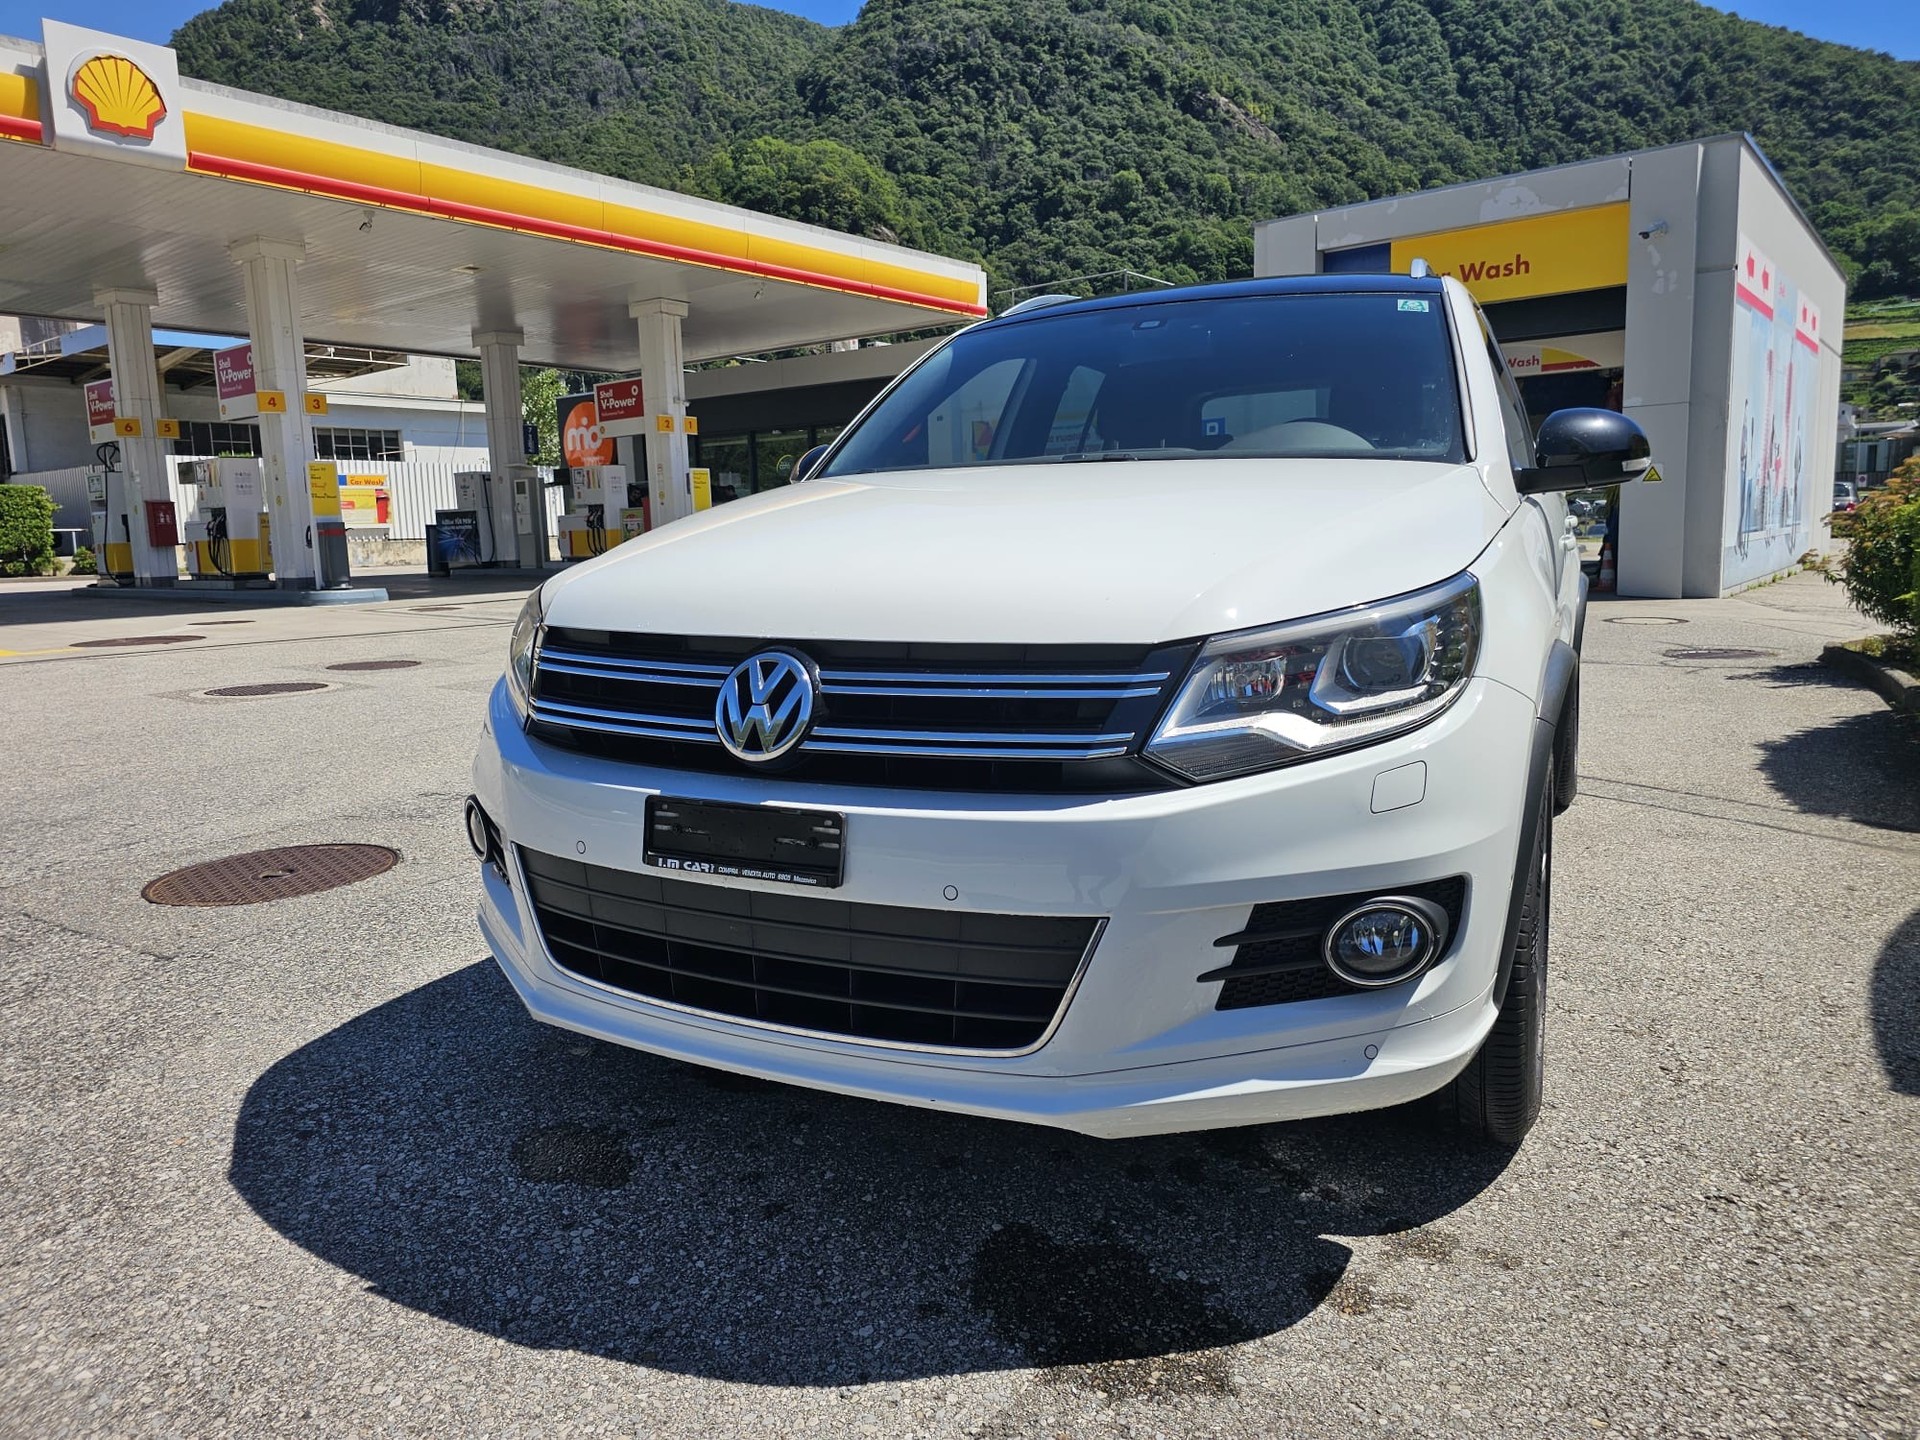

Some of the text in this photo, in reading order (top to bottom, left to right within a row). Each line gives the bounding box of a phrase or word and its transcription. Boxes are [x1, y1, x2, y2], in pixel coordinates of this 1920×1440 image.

[1459, 254, 1530, 282] Wash
[219, 358, 231, 369] Shell
[219, 367, 253, 384] V-Power
[599, 389, 614, 399] Shell
[267, 397, 277, 408] 4
[312, 399, 321, 410] 3
[601, 397, 636, 410] V-Power
[124, 422, 133, 433] 6
[164, 423, 172, 433] 5
[664, 419, 671, 429] 2
[364, 479, 385, 487] Wash
[720, 656, 809, 756] VW
[718, 866, 739, 875] COMPRA
[742, 869, 762, 878] VENDITA
[762, 871, 776, 879] AUTO
